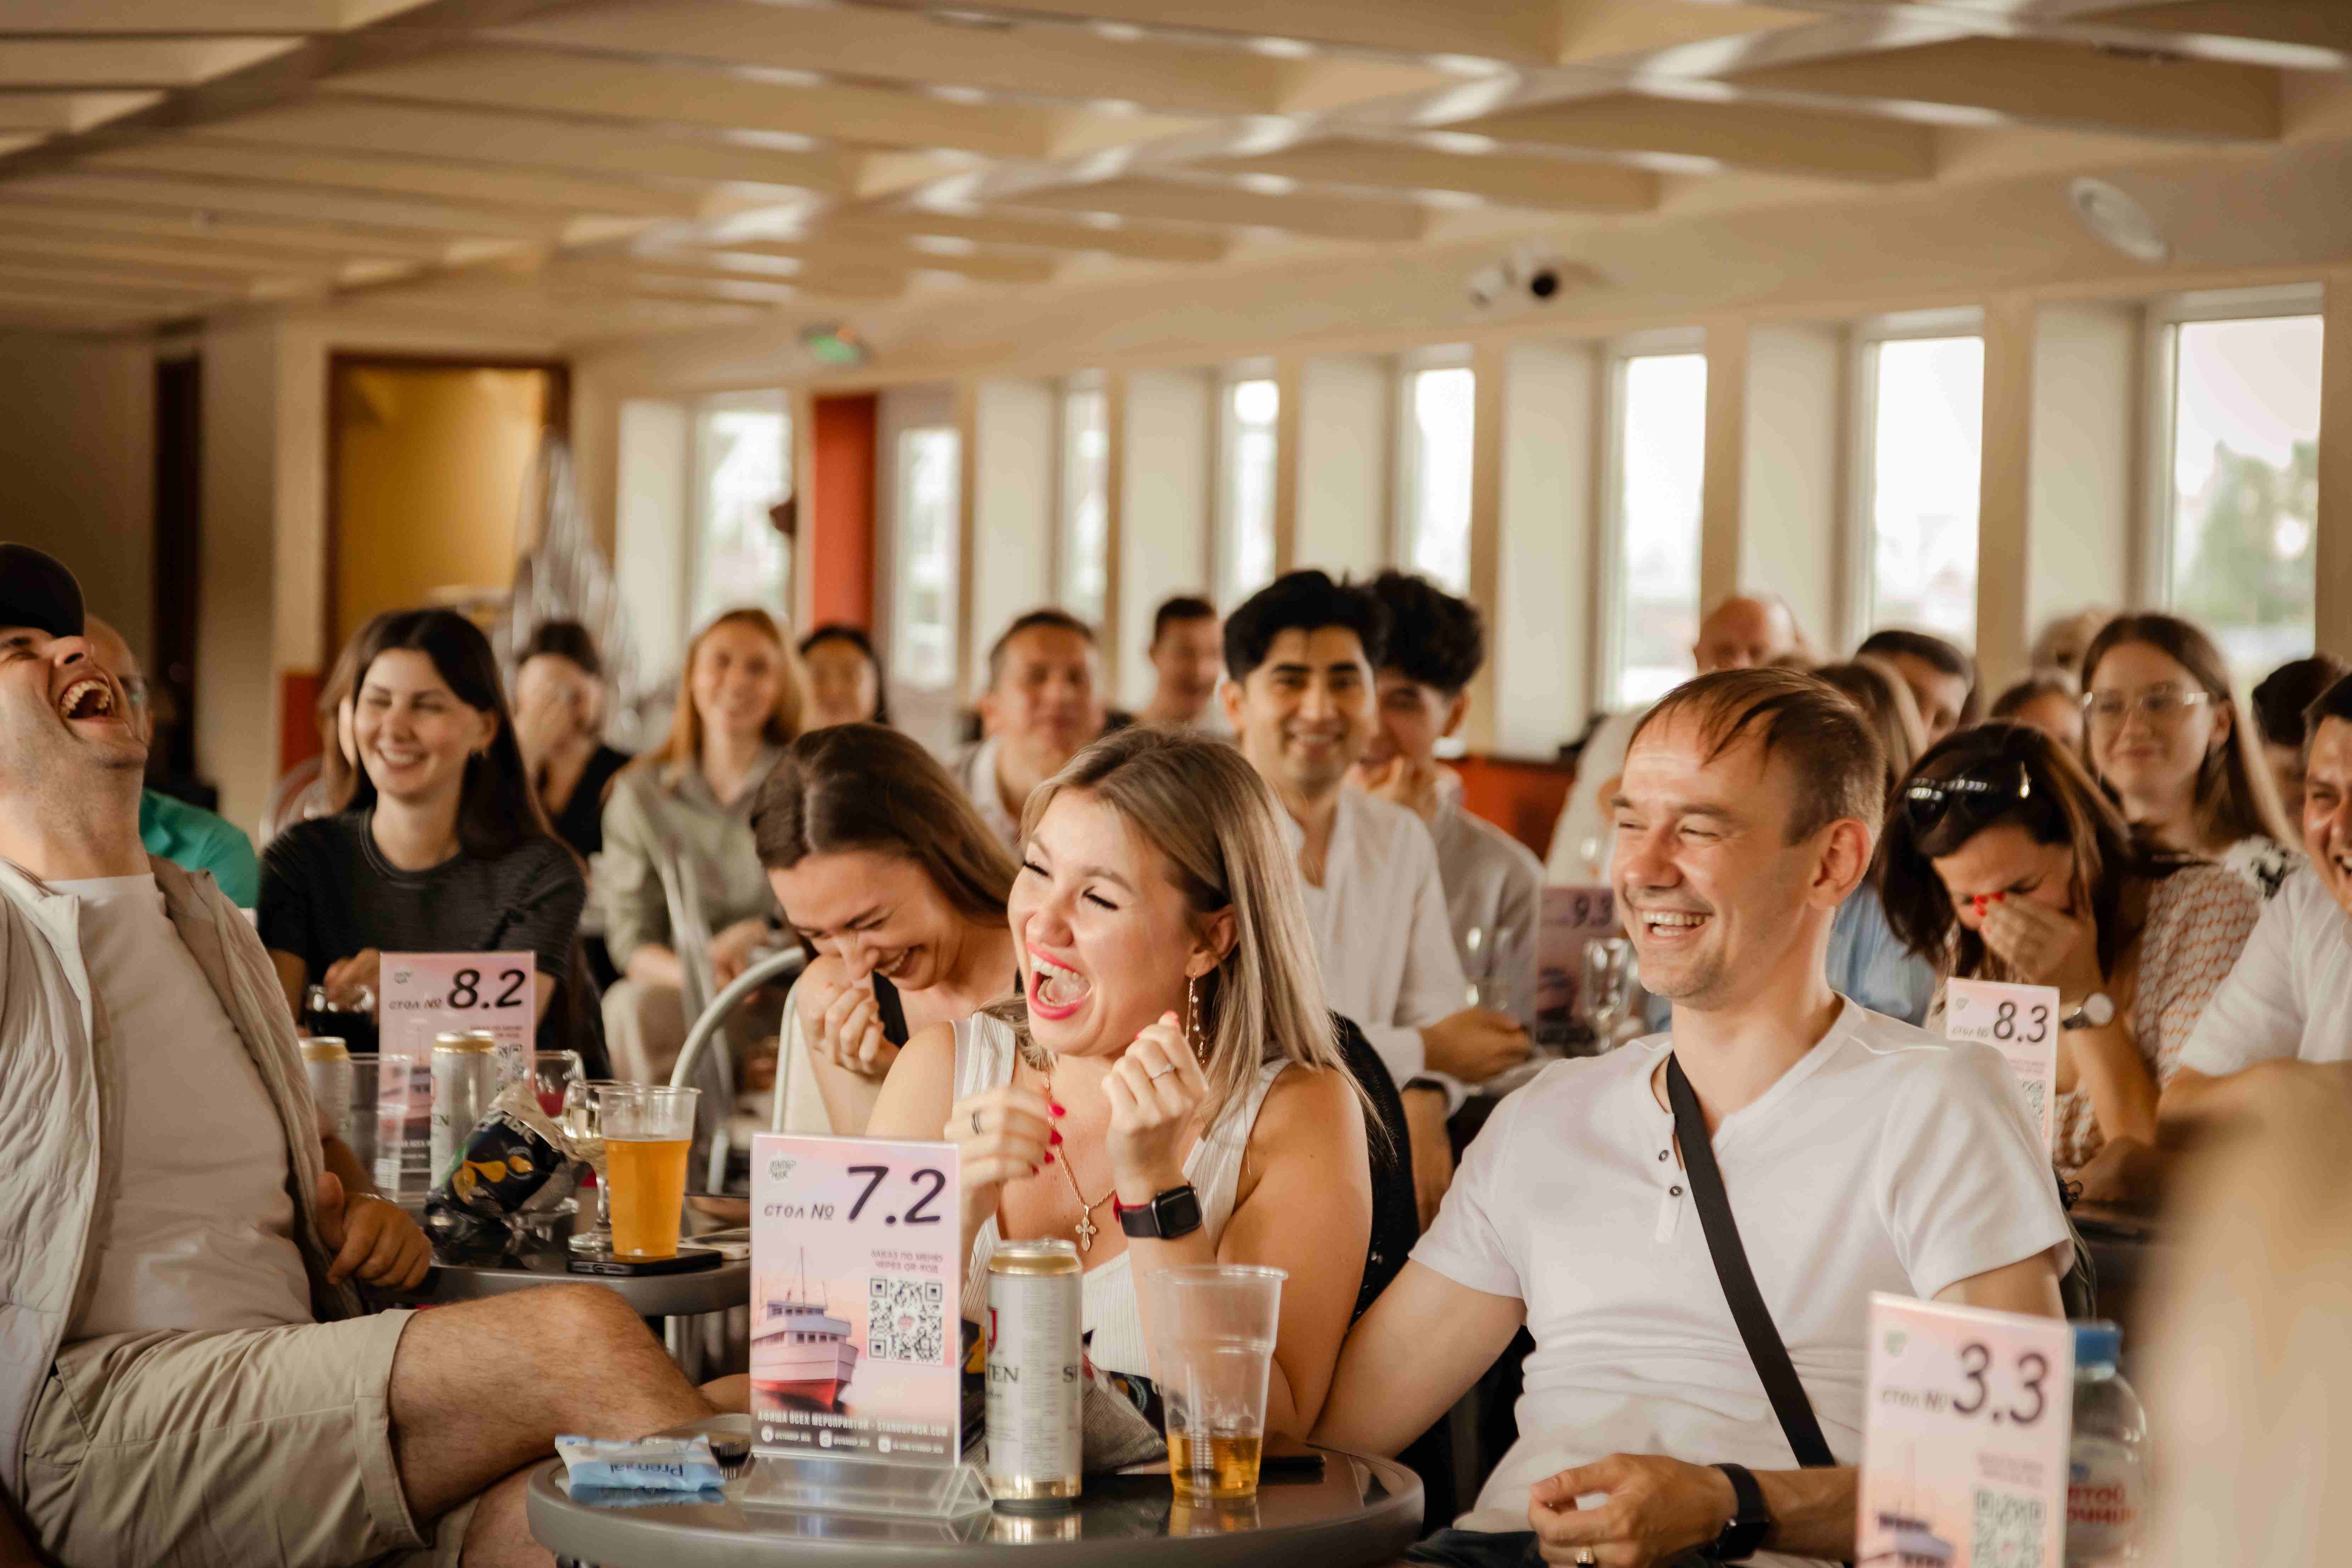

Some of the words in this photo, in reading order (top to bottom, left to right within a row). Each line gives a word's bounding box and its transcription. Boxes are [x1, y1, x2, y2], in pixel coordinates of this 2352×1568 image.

[447, 969, 525, 1009] 8.2
[1994, 1001, 2047, 1042] 8.3
[848, 1165, 946, 1224] 7.2
[900, 1252, 913, 1260] ПО
[916, 1253, 943, 1263] МЕНЮ
[1953, 1343, 2048, 1424] 3.3
[758, 1410, 787, 1423] АФИША
[789, 1410, 810, 1425] ВСЕХ
[877, 1421, 947, 1437] STANDUPMSK.COM
